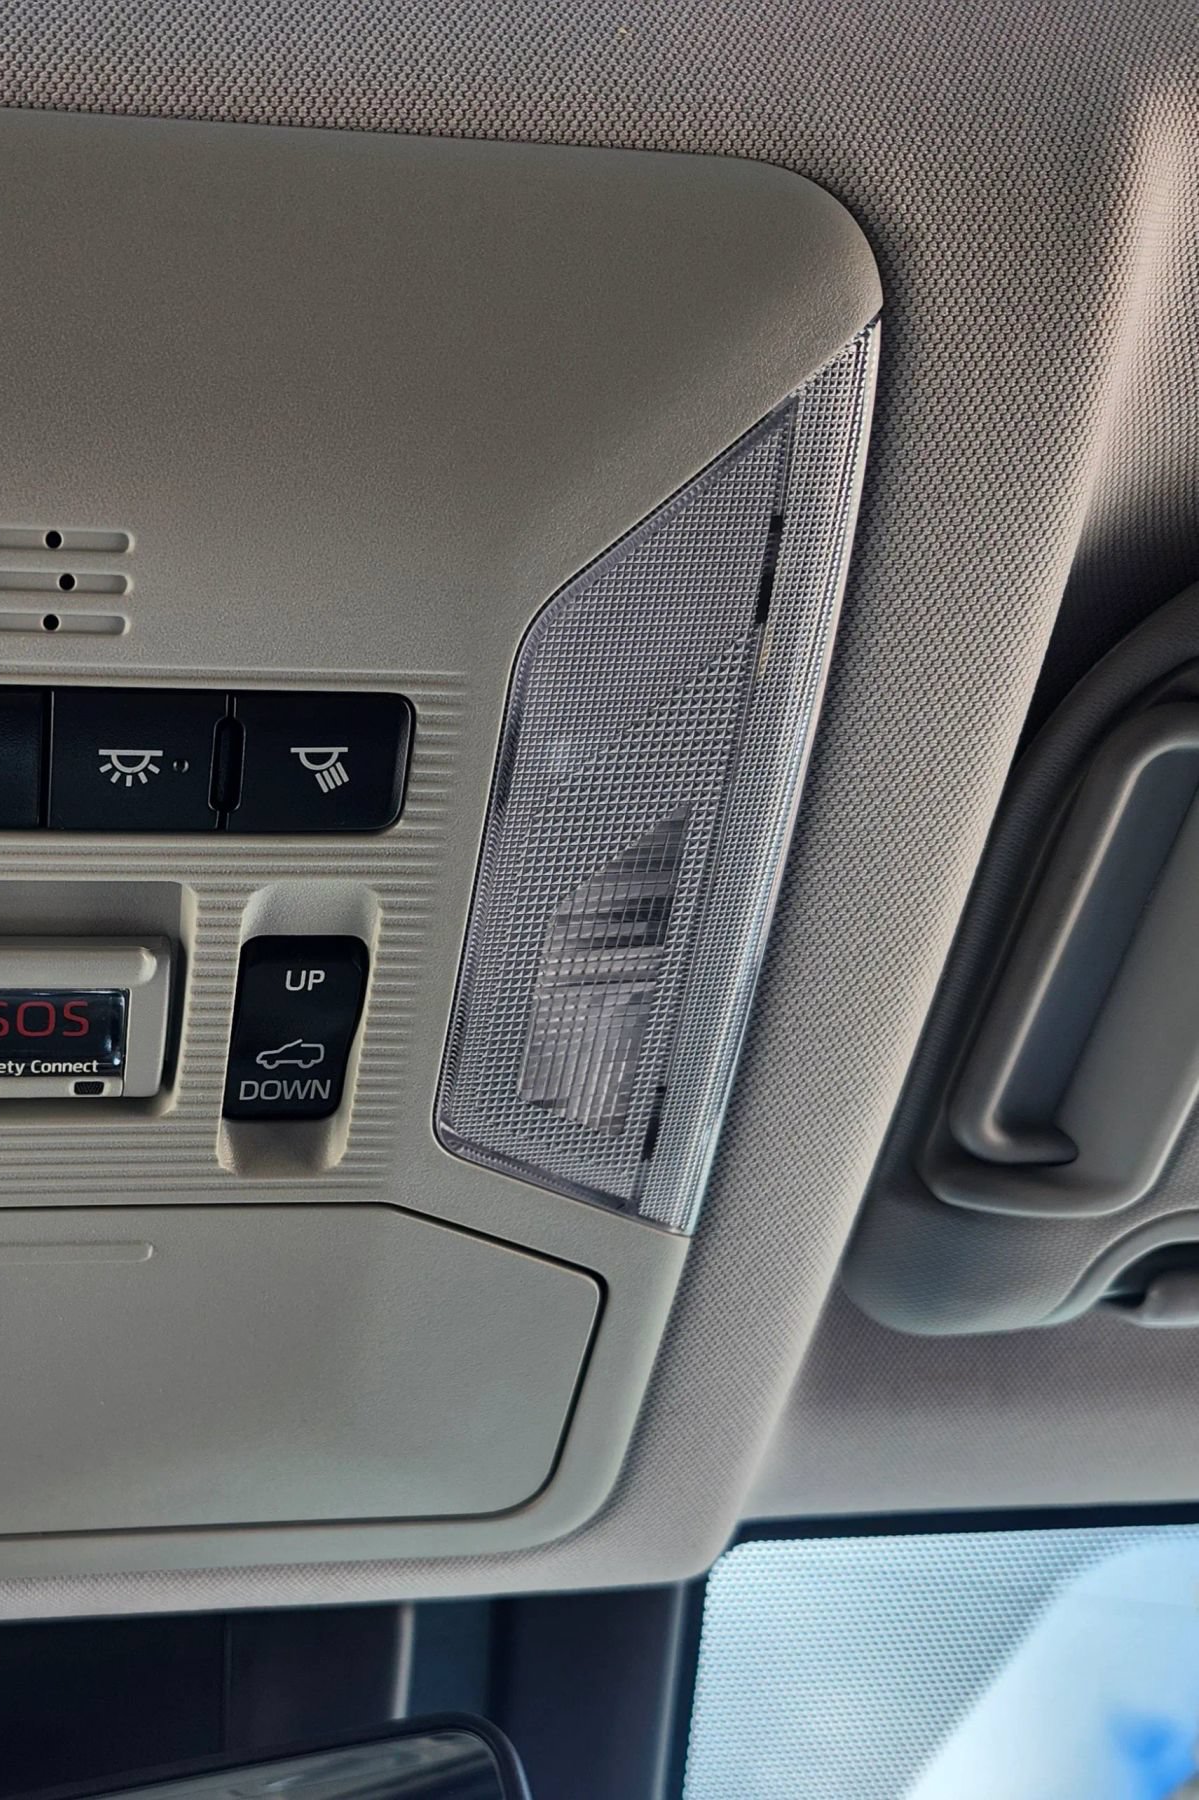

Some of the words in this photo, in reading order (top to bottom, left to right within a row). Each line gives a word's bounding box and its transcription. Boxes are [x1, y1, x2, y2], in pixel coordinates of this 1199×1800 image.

[285, 970, 326, 991] UP
[30, 1059, 99, 1074] Connect
[239, 1079, 331, 1101] DOWN
